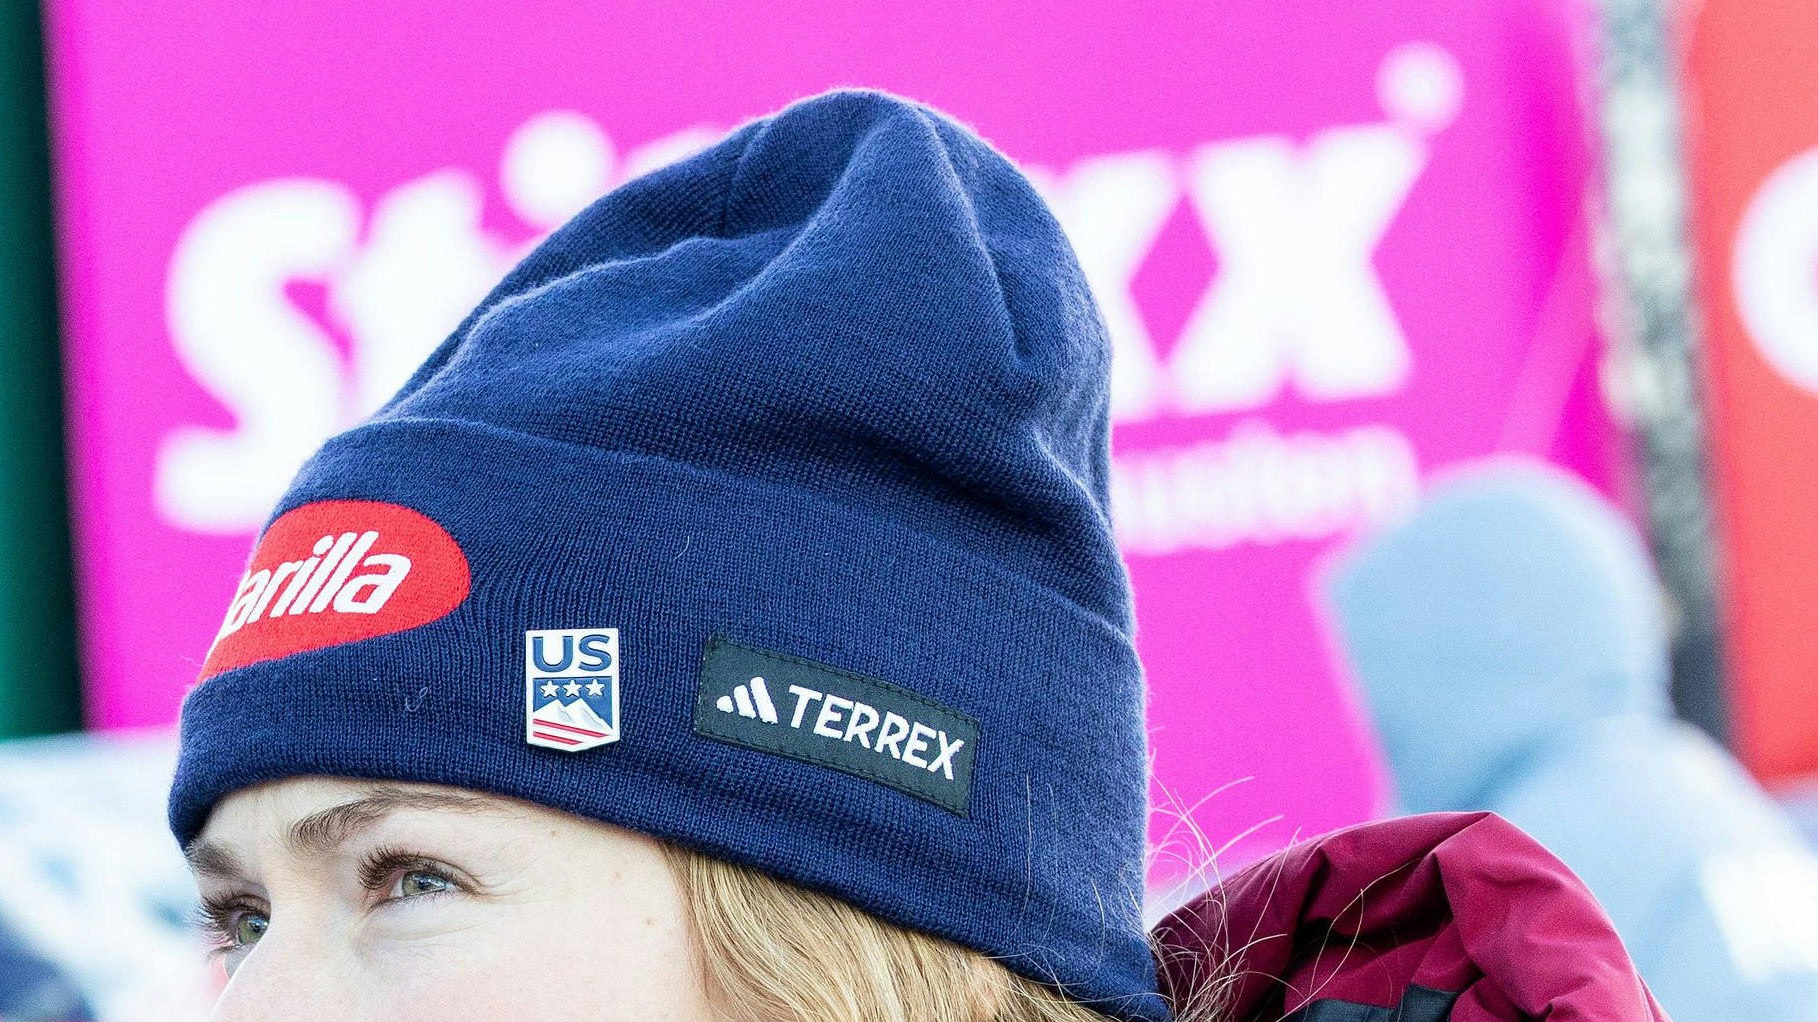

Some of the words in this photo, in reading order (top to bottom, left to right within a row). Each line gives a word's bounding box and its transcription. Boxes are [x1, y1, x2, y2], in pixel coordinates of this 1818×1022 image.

[204, 530, 413, 664] arilla
[532, 633, 613, 673] US
[789, 684, 965, 781] TERREX
